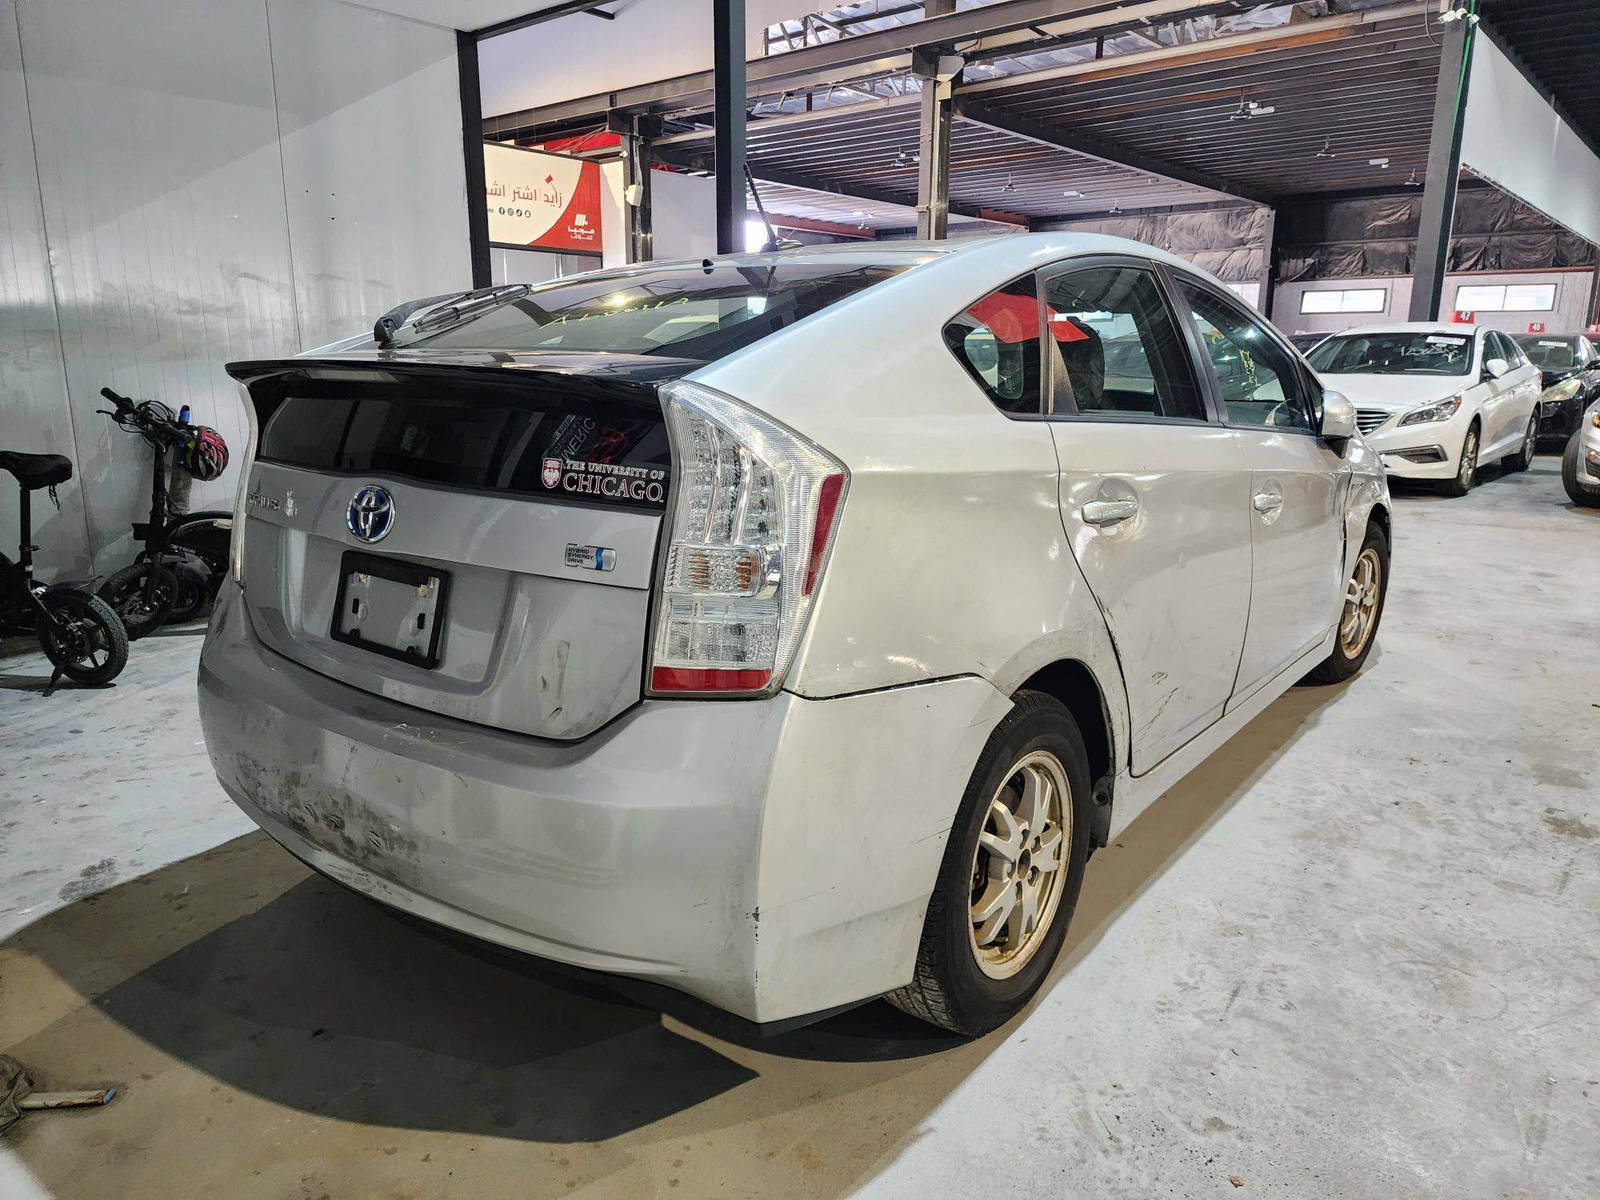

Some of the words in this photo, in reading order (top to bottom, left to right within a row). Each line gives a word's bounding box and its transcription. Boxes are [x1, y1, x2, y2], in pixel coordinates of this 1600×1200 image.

[512, 186, 537, 202] اشتر
[566, 460, 586, 471] THE
[588, 463, 649, 479] UNIVERSITY
[650, 470, 665, 480] OF
[563, 472, 663, 502] CHICAGO
[568, 552, 594, 560] SYNERGY
